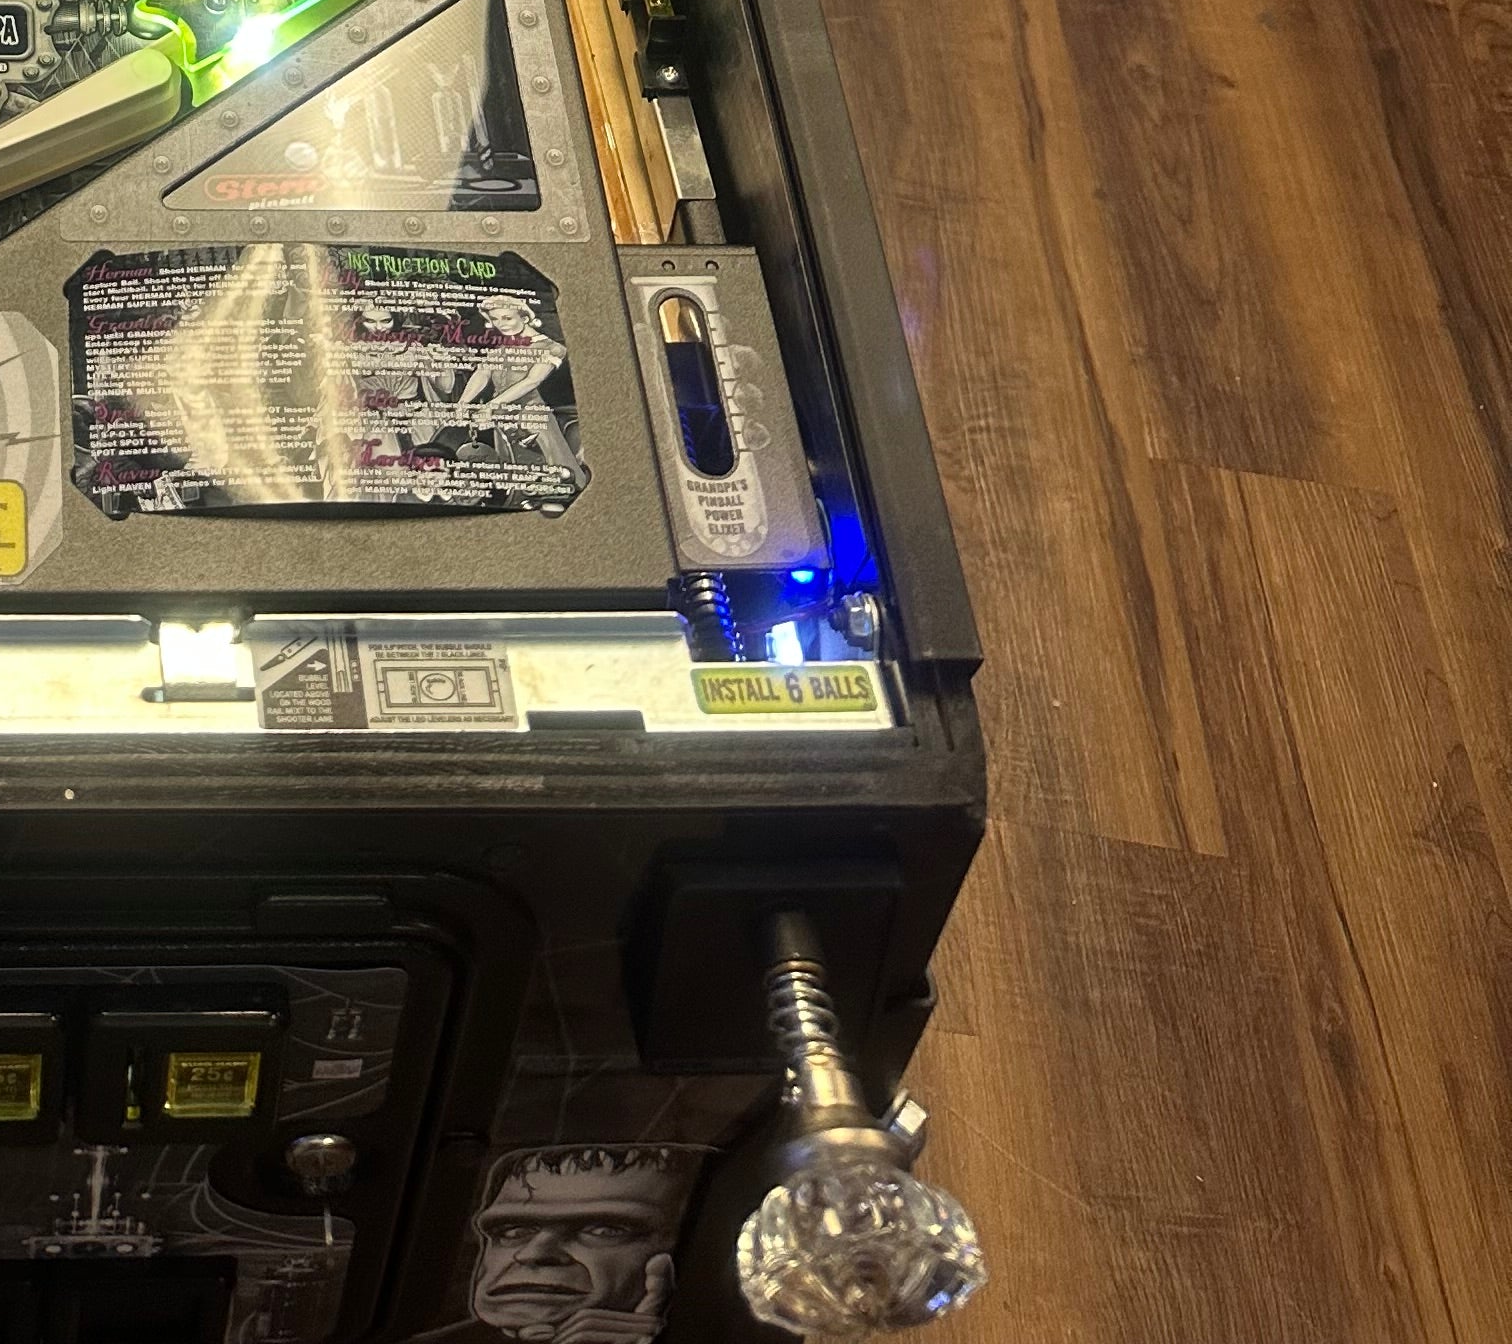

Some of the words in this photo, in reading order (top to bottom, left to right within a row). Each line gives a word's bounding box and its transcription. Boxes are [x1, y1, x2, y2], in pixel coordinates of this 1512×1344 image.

[248, 195, 315, 210] pinball
[86, 260, 153, 282] Herman
[186, 265, 227, 274] HERMAN
[347, 250, 450, 279] INSTRUCTION
[455, 256, 497, 280] CARD
[131, 293, 172, 301] HERMAN
[84, 303, 125, 311] HERMAN
[127, 301, 159, 309] SUPER
[119, 439, 146, 447] SPOT
[90, 448, 116, 457] SPOT
[479, 472, 509, 480] RIGHT
[118, 482, 152, 492] RAVEN
[687, 479, 748, 494] GRANDPA'S
[698, 494, 745, 507] PINBALL
[704, 509, 744, 521] POWER
[708, 523, 746, 536] ELIXER
[298, 675, 329, 683] BUBBLE
[700, 677, 781, 705] INSTALL
[785, 671, 804, 705] 6
[809, 674, 871, 702] BALLS
